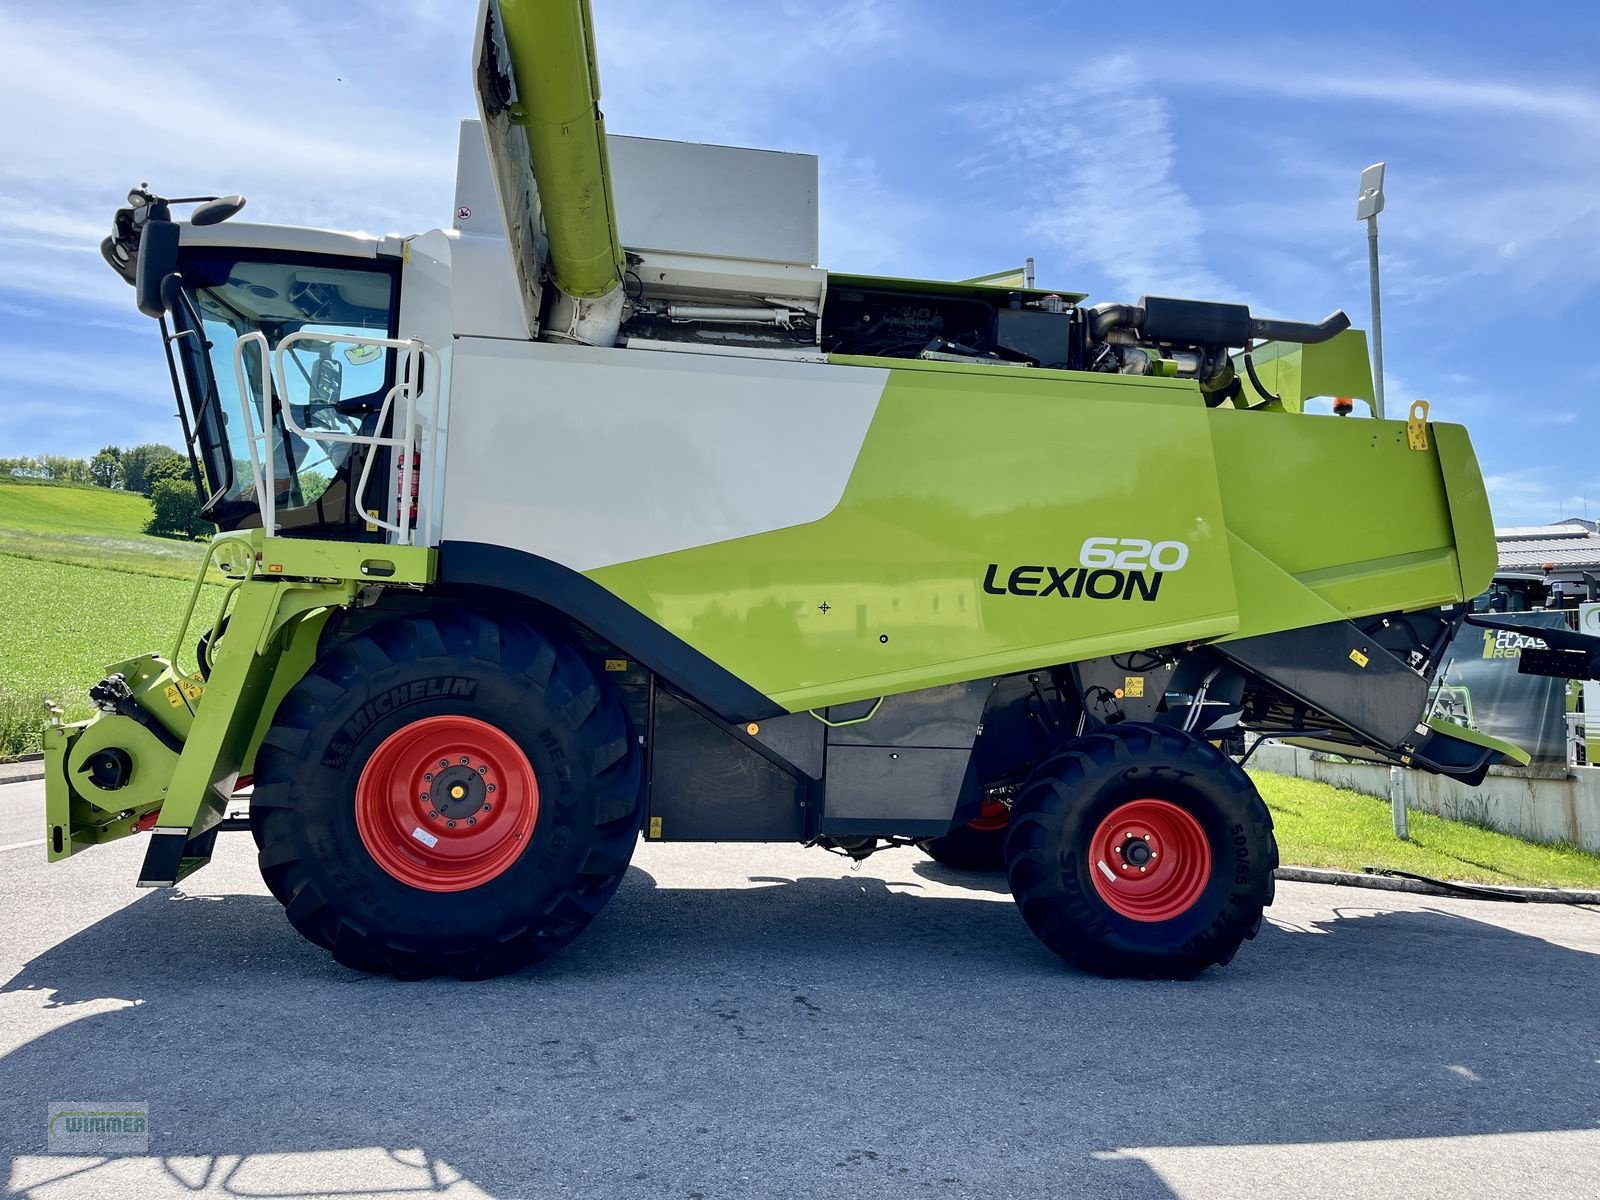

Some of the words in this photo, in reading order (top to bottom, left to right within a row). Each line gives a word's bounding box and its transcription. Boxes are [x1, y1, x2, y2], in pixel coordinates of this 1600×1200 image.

[1079, 537, 1189, 572] 620
[983, 564, 1163, 601] LEXION
[1496, 629, 1528, 639] FIR
[343, 677, 479, 740] MICHELIN
[1230, 824, 1250, 885] 500/85
